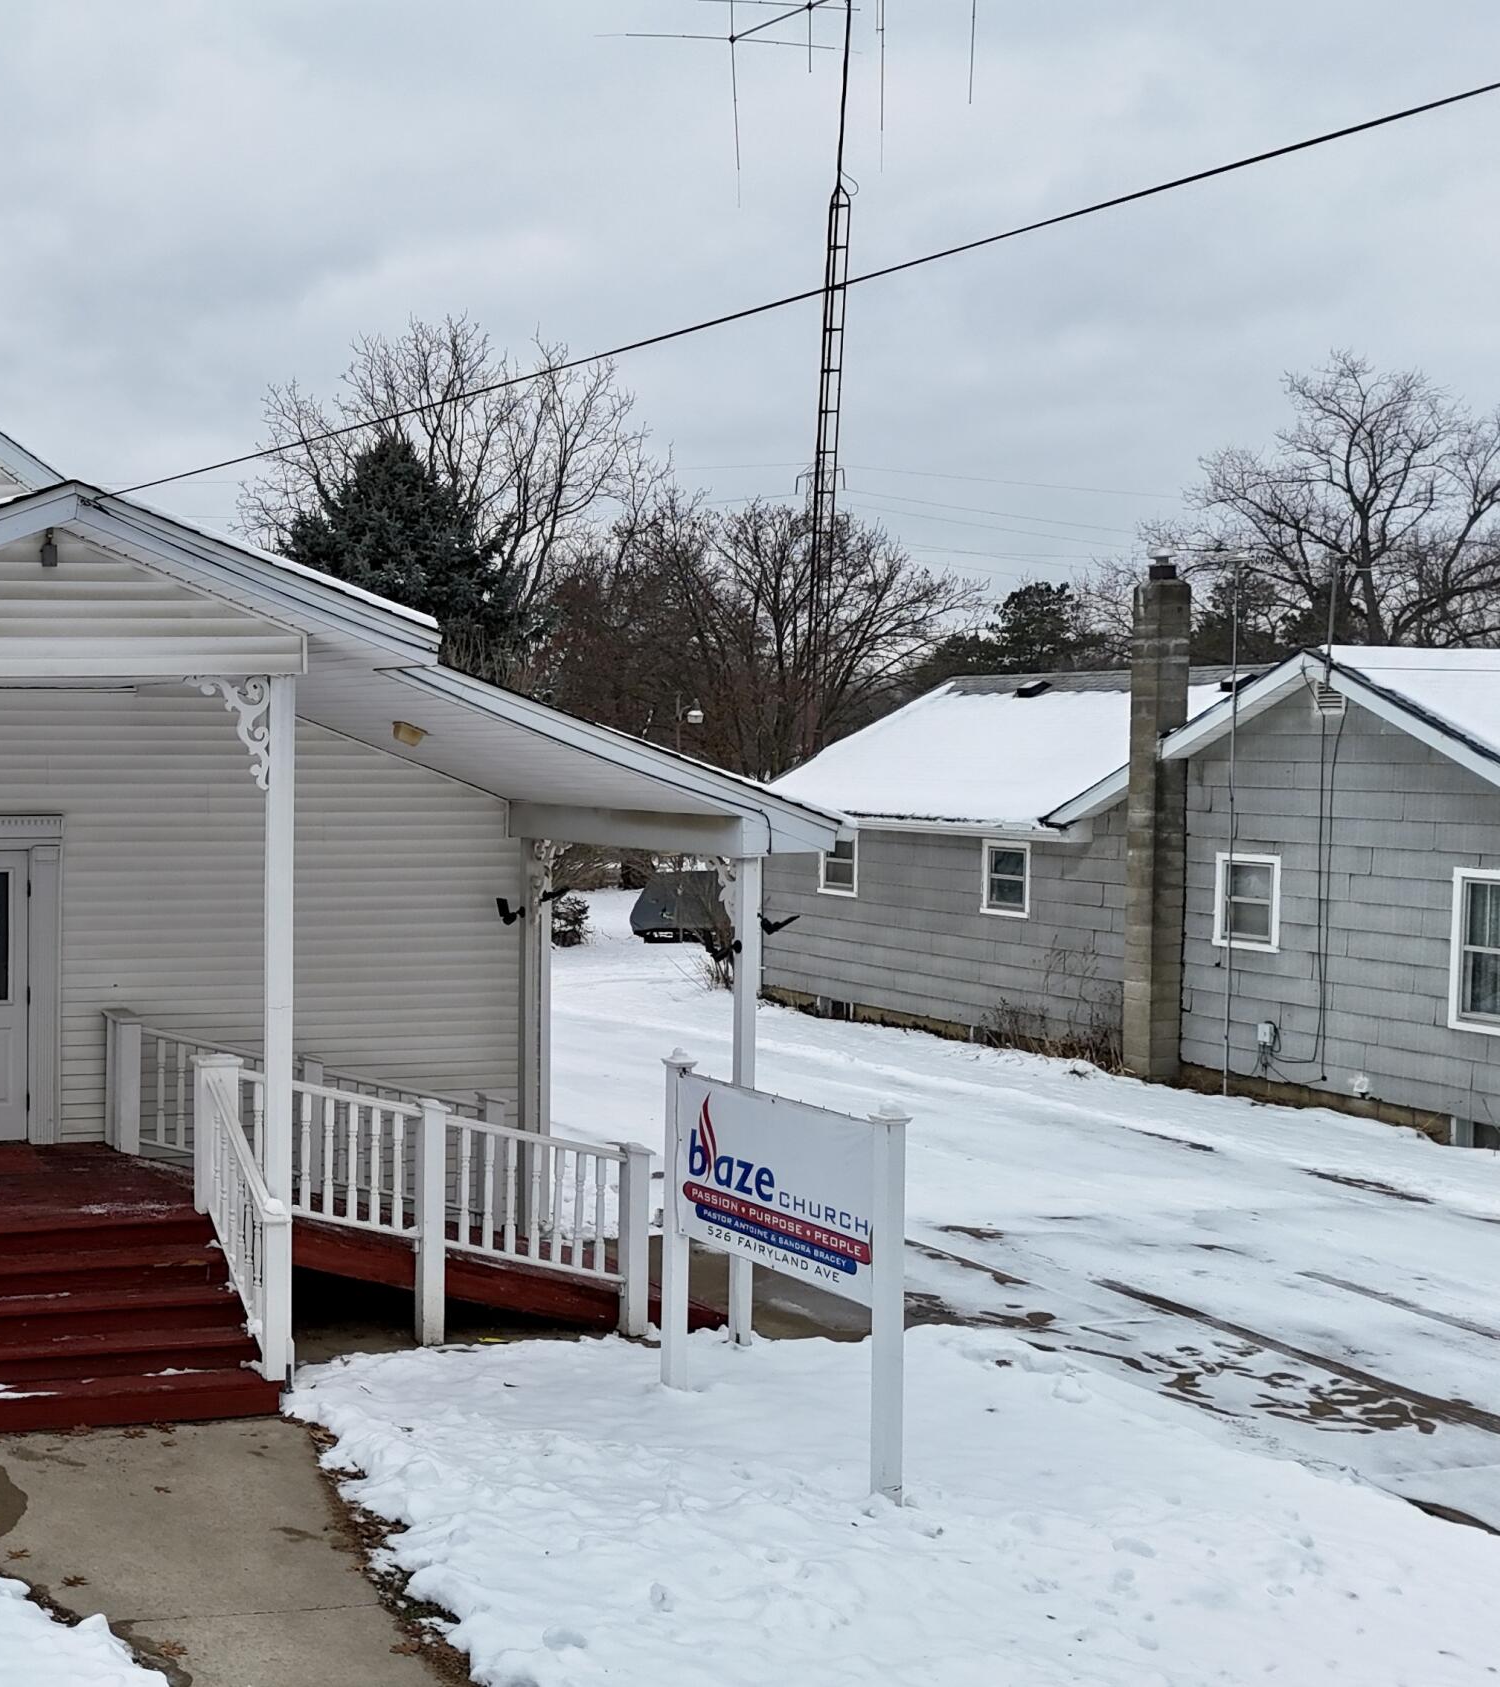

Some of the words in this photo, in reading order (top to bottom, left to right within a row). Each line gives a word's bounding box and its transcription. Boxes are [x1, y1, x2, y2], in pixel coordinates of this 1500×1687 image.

[689, 1091, 775, 1202] blaze
[778, 1191, 869, 1236] CHURCH
[691, 1188, 739, 1212] PASSION
[749, 1207, 803, 1236] PURPOSE
[814, 1230, 862, 1257] PEOPLE
[703, 1208, 733, 1226] PASTOR
[733, 1220, 769, 1240] ANTOINE
[770, 1233, 777, 1242] &
[778, 1236, 812, 1255] SANDRA
[813, 1248, 848, 1268] BRACEY
[707, 1225, 732, 1242] 526
[737, 1236, 809, 1271] FAIRYLAND
[814, 1265, 840, 1284] AVE
